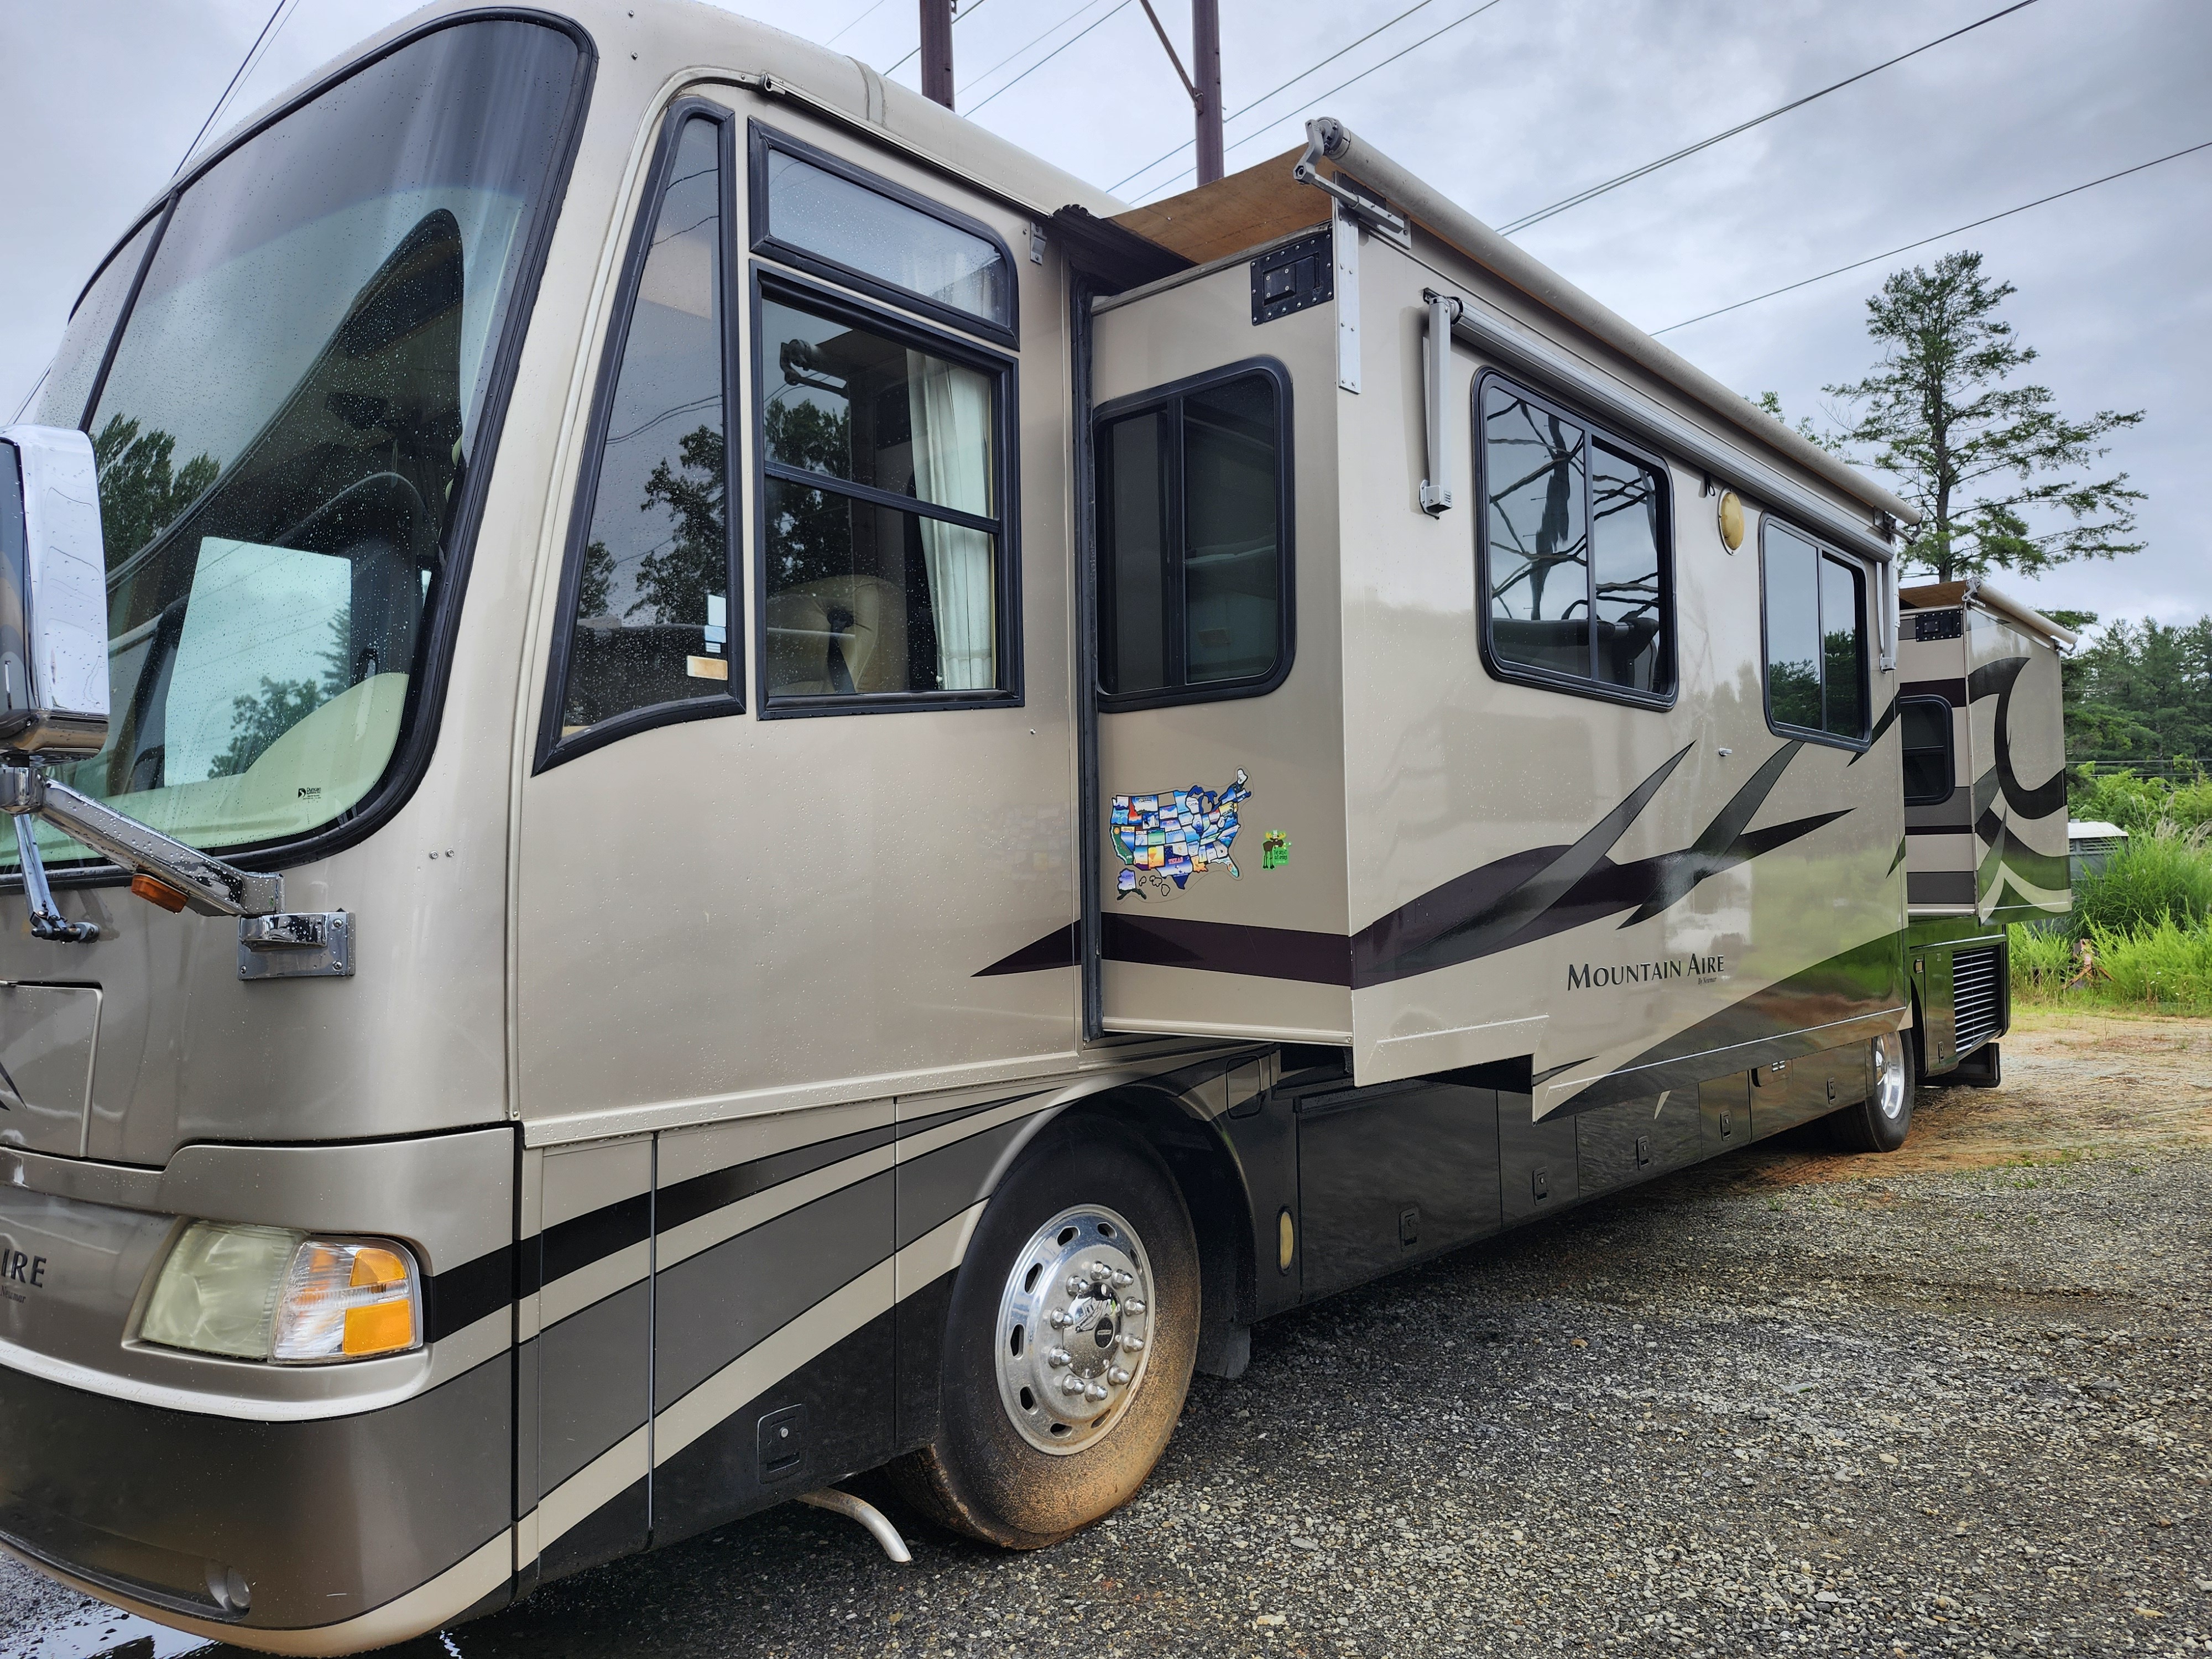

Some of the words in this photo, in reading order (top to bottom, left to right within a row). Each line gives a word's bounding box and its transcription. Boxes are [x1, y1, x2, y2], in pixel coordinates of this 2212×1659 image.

[1168, 856, 1184, 864] TEXAS
[1567, 959, 1681, 991] MOUNTAIN
[1687, 953, 1724, 977] AIRE
